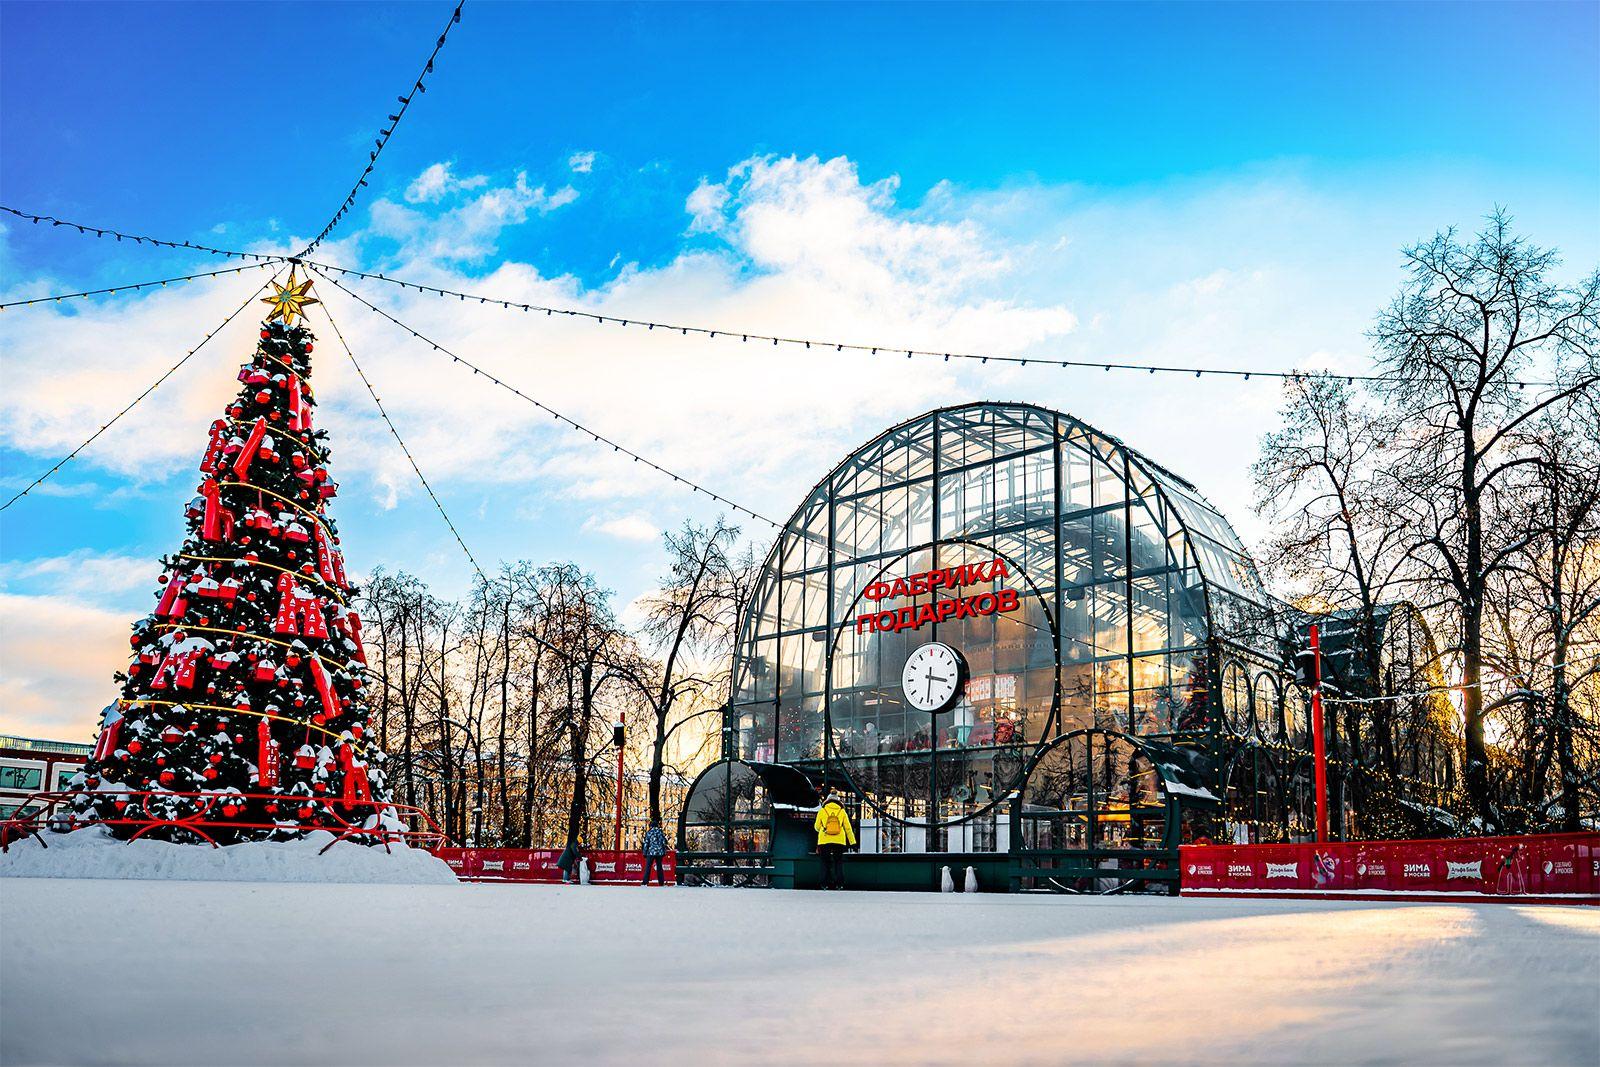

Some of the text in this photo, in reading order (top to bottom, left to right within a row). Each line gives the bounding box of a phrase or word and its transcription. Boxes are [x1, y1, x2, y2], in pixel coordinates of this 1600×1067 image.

[863, 557, 1009, 602] ФАБРИКА
[857, 589, 1020, 635] ПОДАРКОВ
[1404, 864, 1430, 872] ЗИМА
